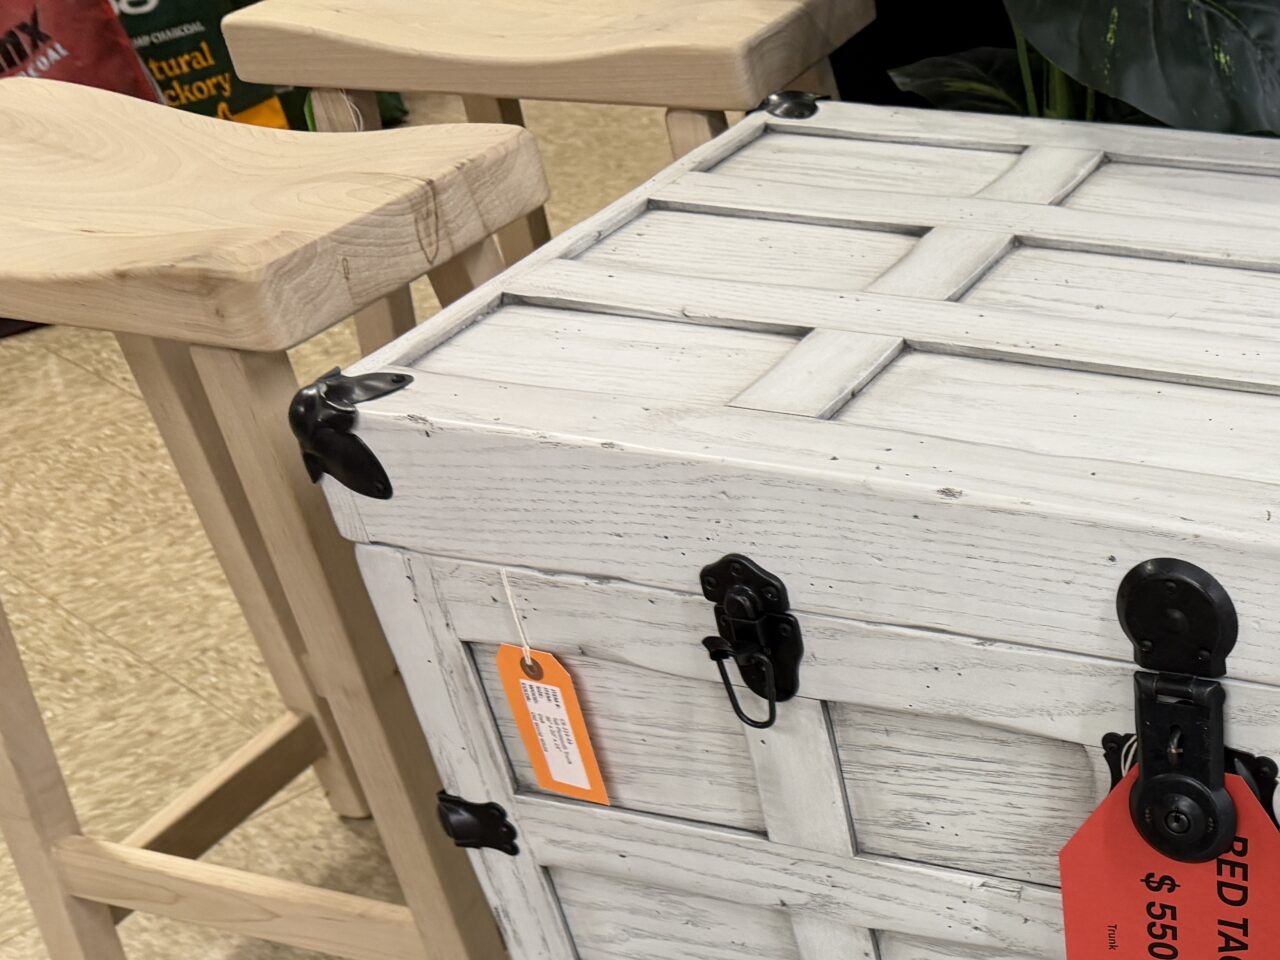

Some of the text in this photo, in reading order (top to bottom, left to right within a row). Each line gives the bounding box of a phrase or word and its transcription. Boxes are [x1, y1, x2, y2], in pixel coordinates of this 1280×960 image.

[1140, 872, 1181, 893] $
[1216, 835, 1249, 907] RED
[1107, 924, 1118, 951] Trunk
